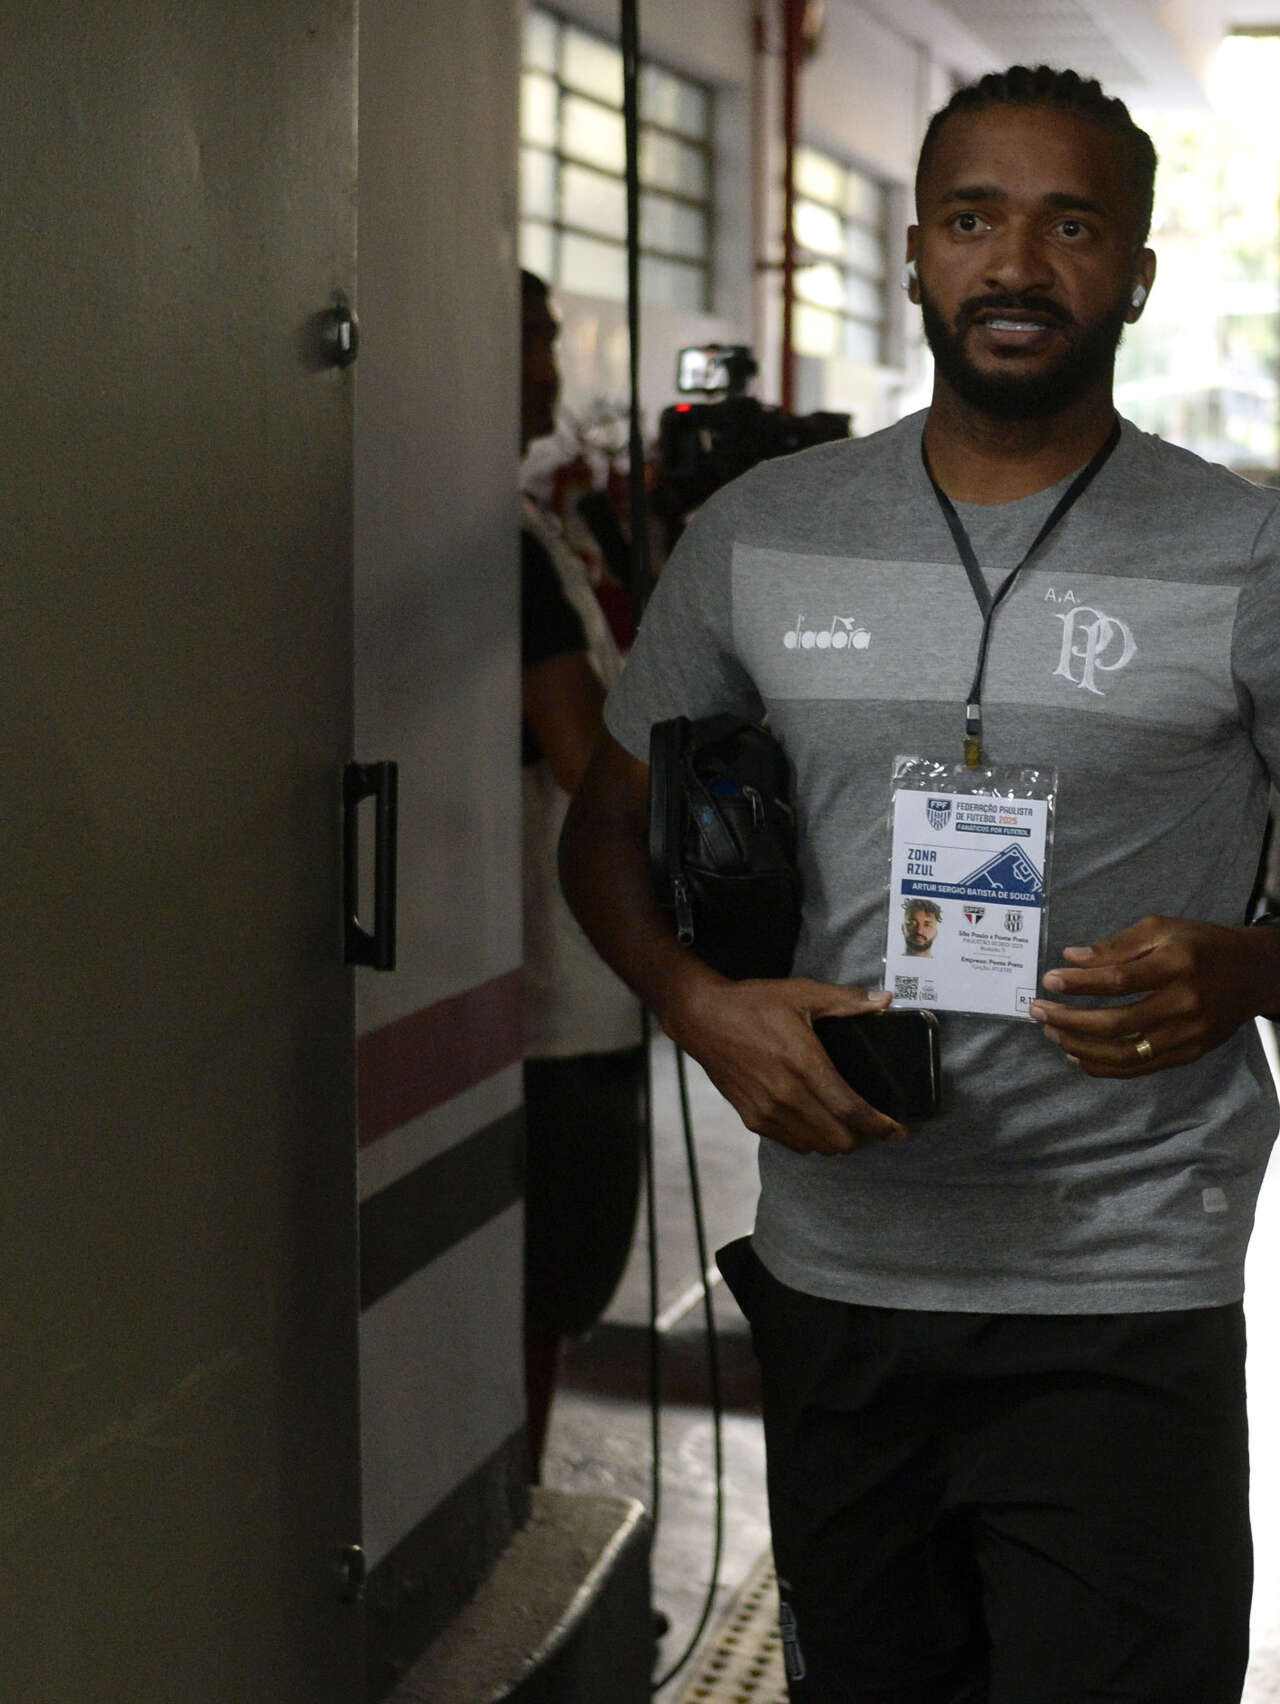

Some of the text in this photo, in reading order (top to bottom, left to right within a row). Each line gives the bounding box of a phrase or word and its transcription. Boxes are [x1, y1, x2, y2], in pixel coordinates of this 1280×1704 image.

[1044, 587, 1082, 604] A.A.
[784, 615, 871, 649] diadora
[956, 801, 1033, 817] FEDERAÇÃO PAULISTA
[956, 812, 965, 821] DE
[966, 813, 997, 824] FUTEBOL
[908, 849, 937, 863] ZONA
[907, 863, 934, 876] AZUL
[911, 881, 937, 892] ARTUR
[967, 887, 997, 898] BATISTA
[998, 891, 1009, 899] DE
[1009, 892, 1036, 901] SOUZA
